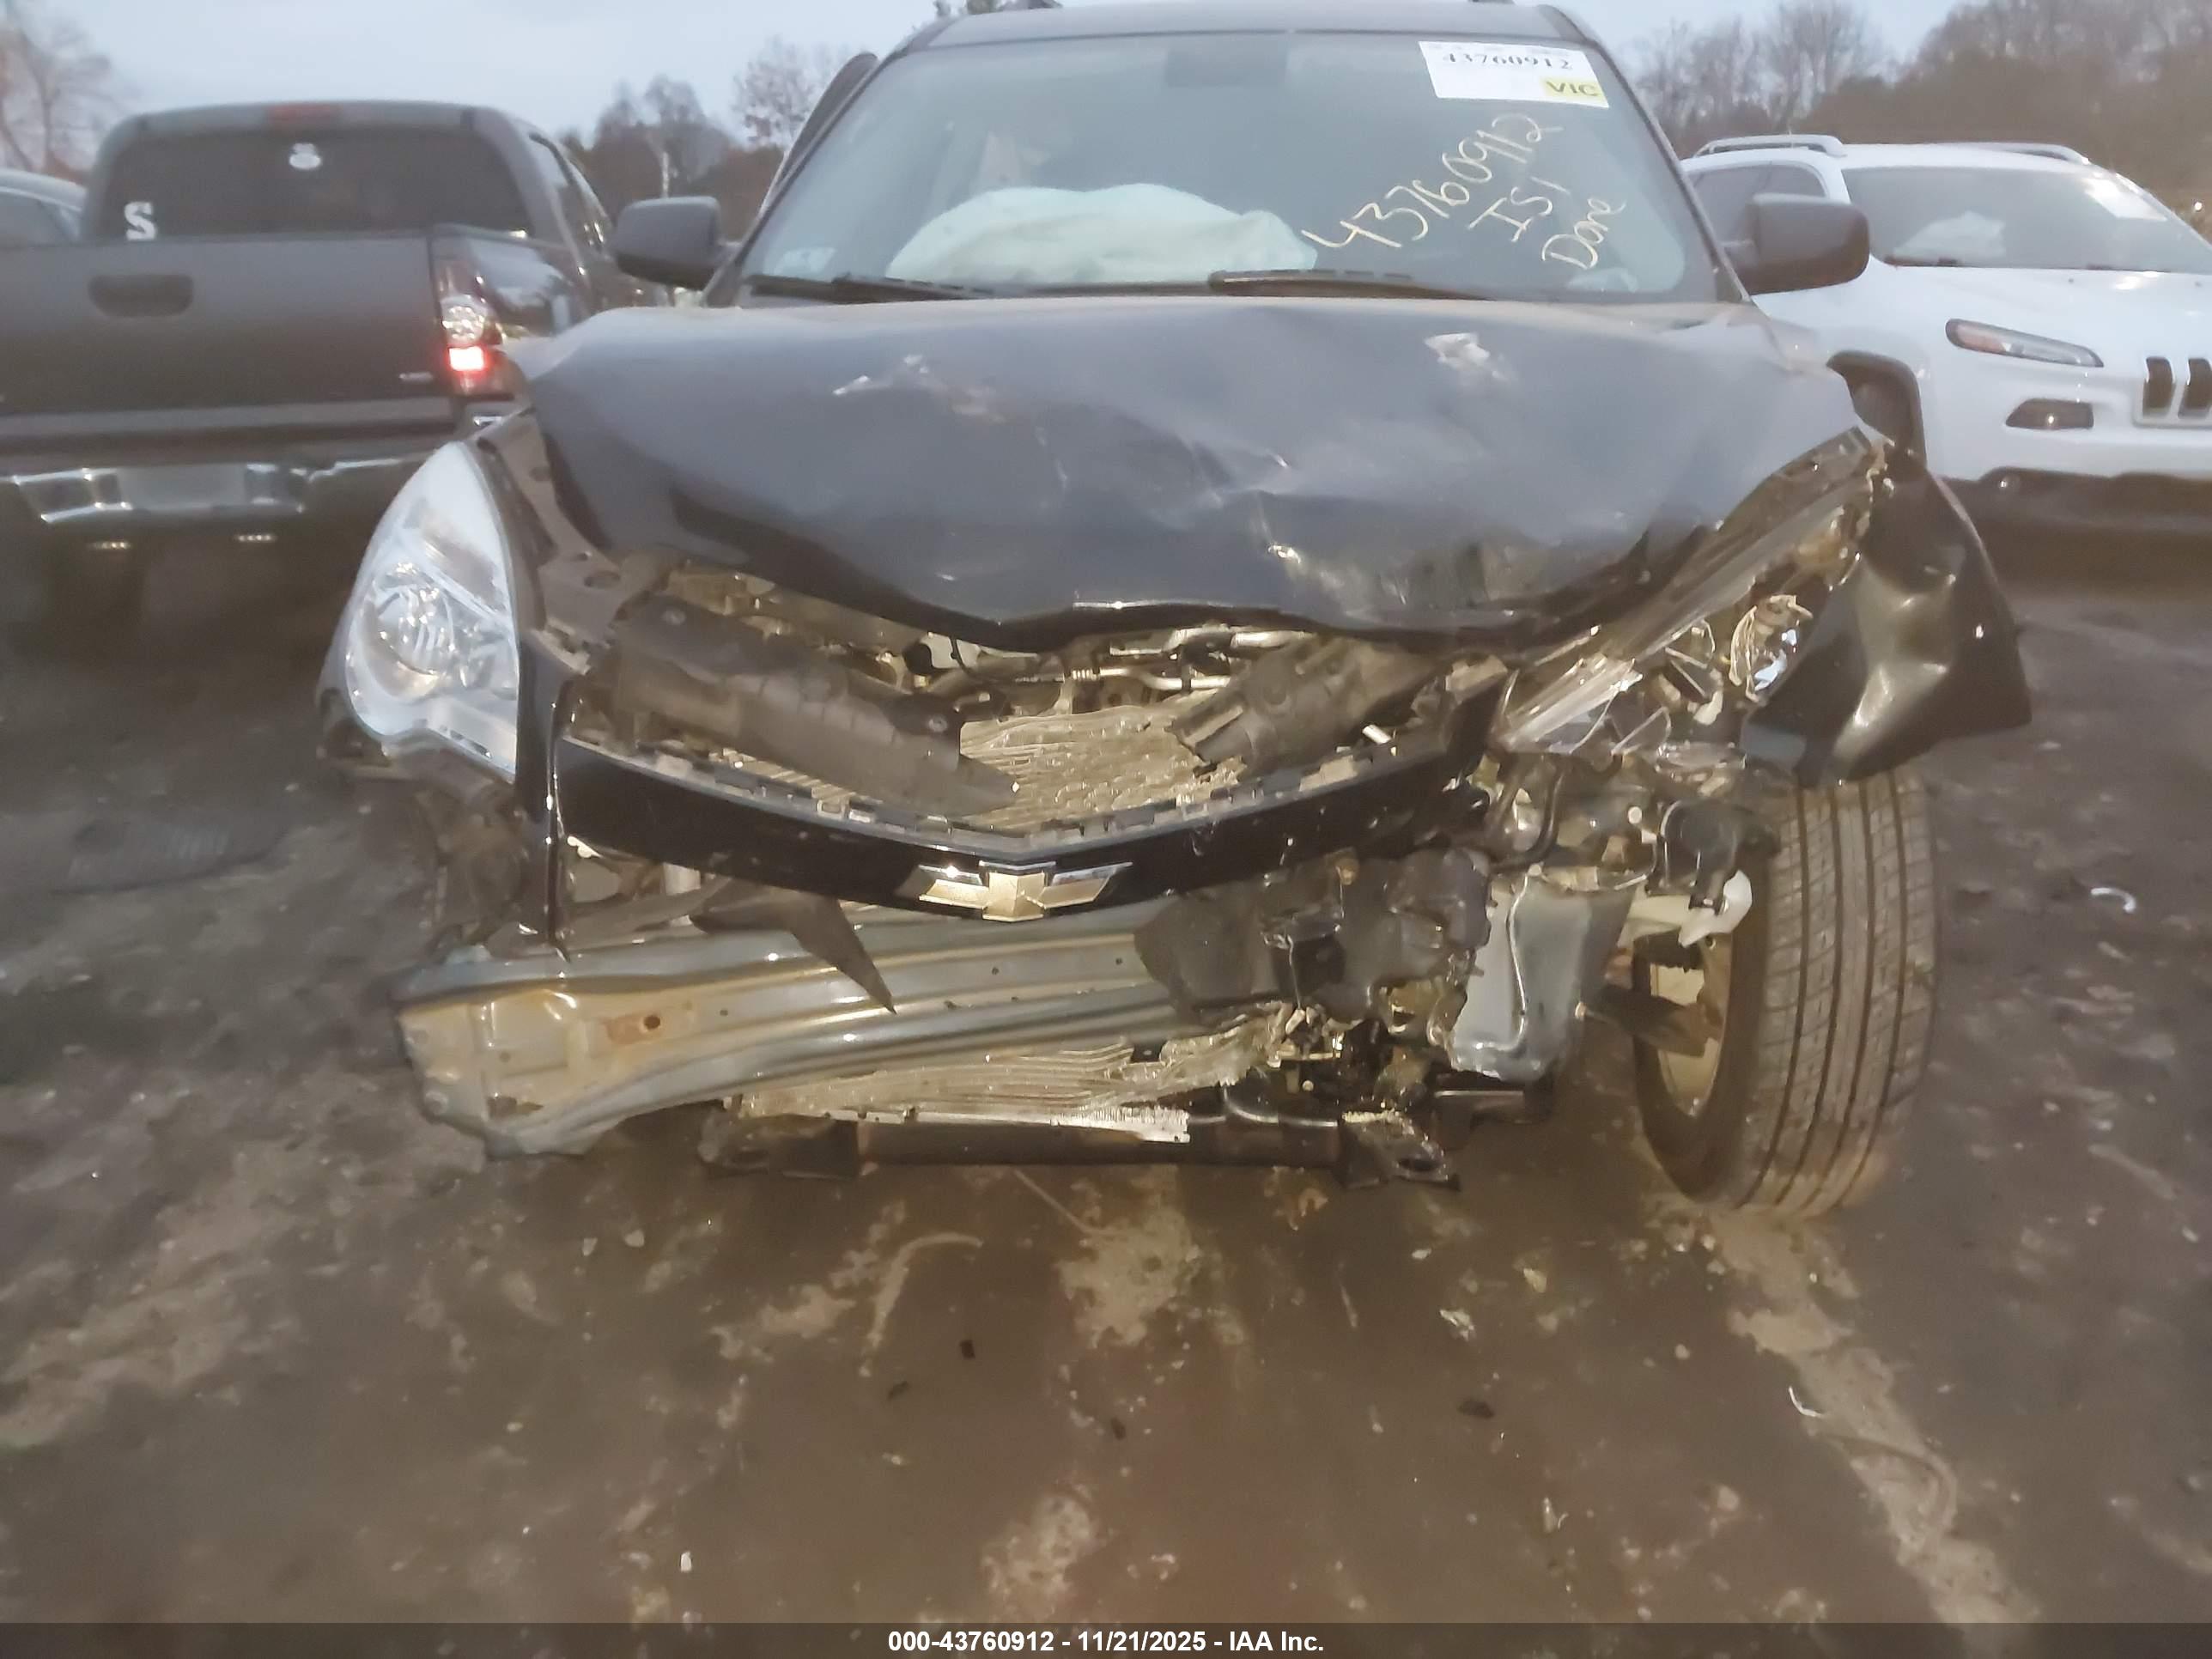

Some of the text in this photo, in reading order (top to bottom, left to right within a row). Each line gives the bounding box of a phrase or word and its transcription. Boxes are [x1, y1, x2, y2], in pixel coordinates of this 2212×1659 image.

[1547, 81, 1600, 97] VIC
[1301, 113, 1564, 248] 43760912
[124, 201, 155, 241] S
